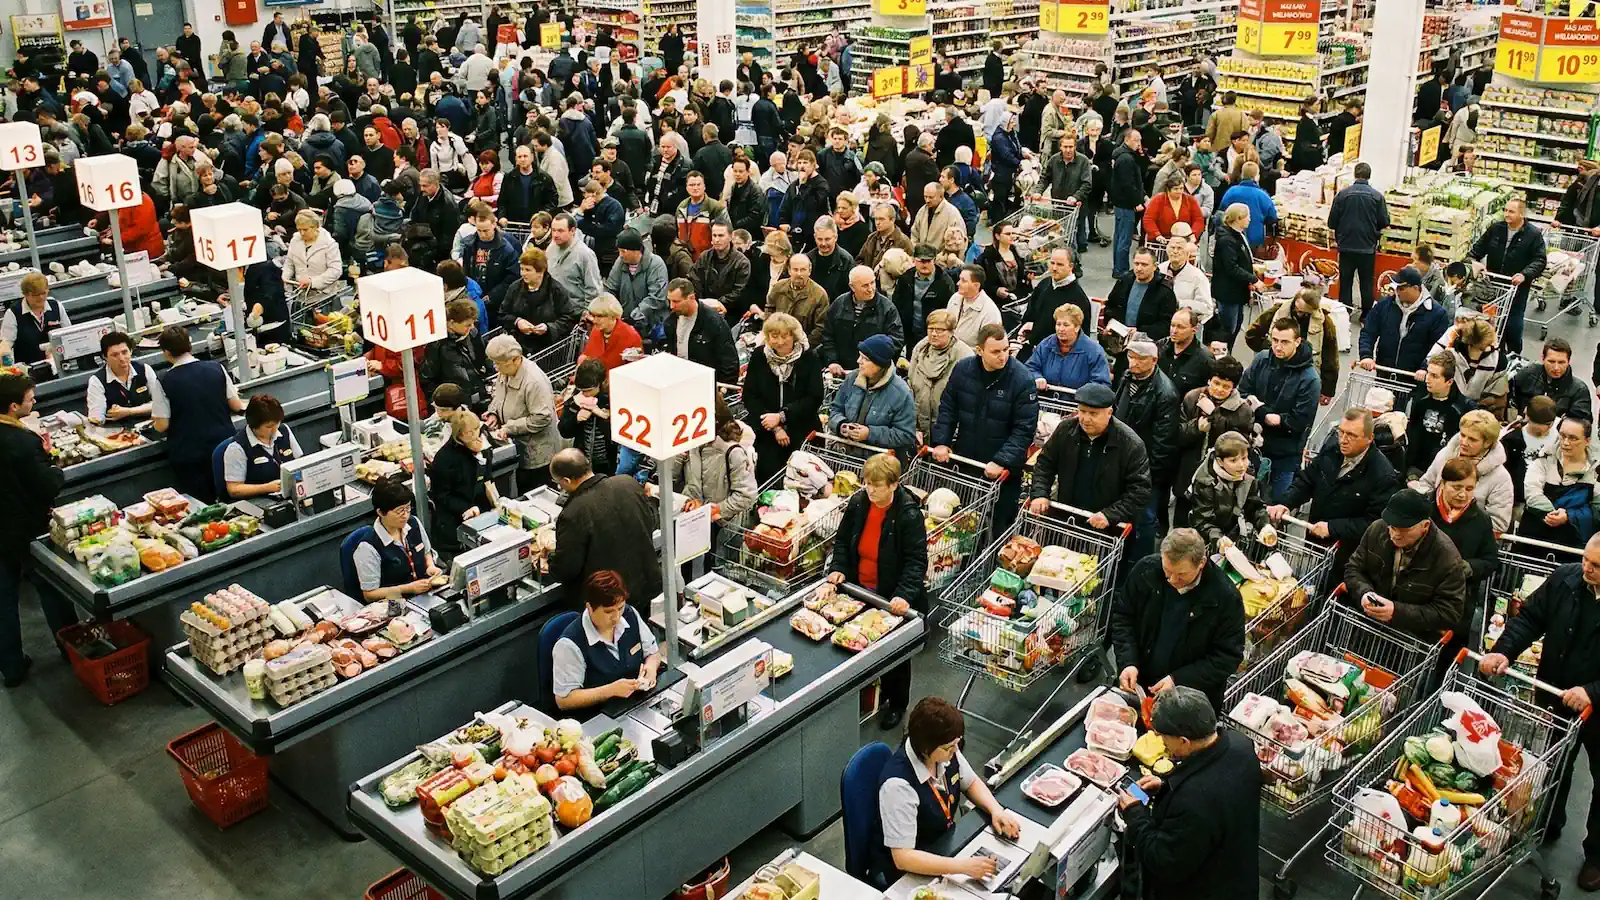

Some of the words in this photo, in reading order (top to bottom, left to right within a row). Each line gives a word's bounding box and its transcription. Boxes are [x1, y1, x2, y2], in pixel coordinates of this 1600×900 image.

[10, 144, 37, 164] 13
[80, 182, 95, 204] 16
[105, 181, 134, 203] 16
[198, 236, 215, 262] 15
[226, 235, 257, 261] 17
[367, 311, 388, 341] 10
[404, 308, 435, 340] 11
[618, 407, 652, 448] 22
[672, 406, 708, 447] 22
